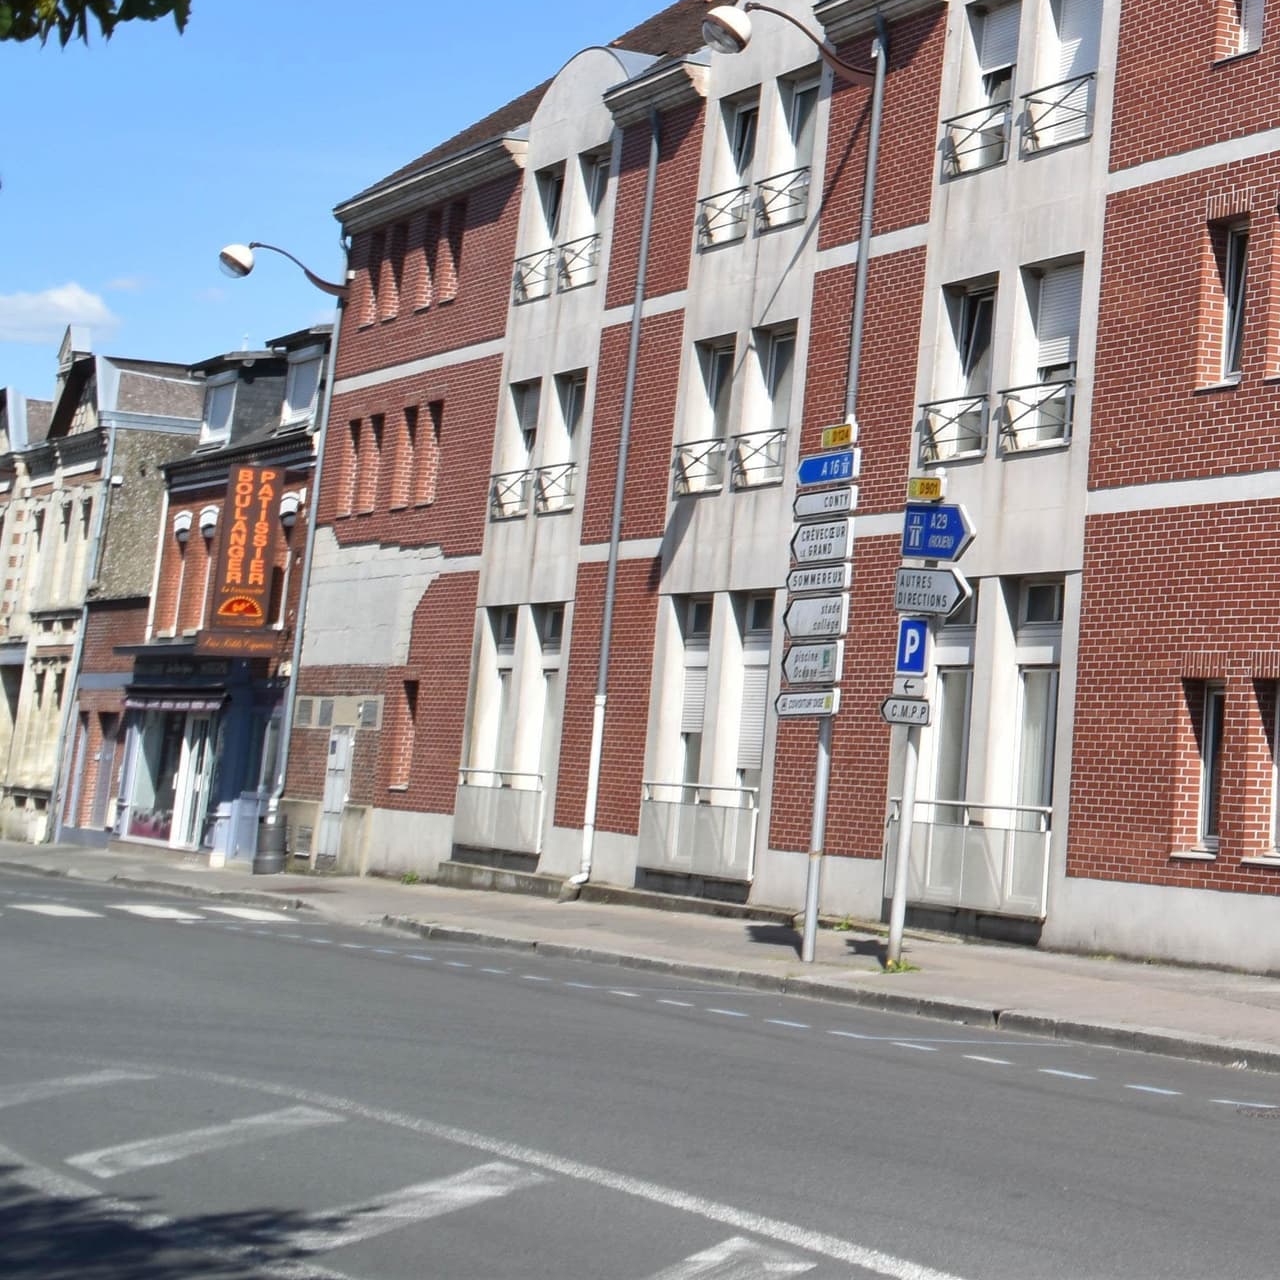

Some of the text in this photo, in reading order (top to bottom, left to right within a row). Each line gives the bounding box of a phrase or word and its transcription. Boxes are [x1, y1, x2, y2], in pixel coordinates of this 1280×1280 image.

[919, 482, 938, 495] D901
[824, 494, 849, 508] CONTY
[226, 469, 253, 584] BOULANGER
[248, 471, 276, 585] PATISSIER
[930, 513, 948, 529] A29
[808, 542, 833, 557] GRAND
[793, 571, 843, 587] SOMMEREUX
[899, 574, 932, 589] AUTRES
[897, 591, 948, 607] DIRECTIONS
[821, 602, 841, 615] stade
[903, 628, 920, 664] P
